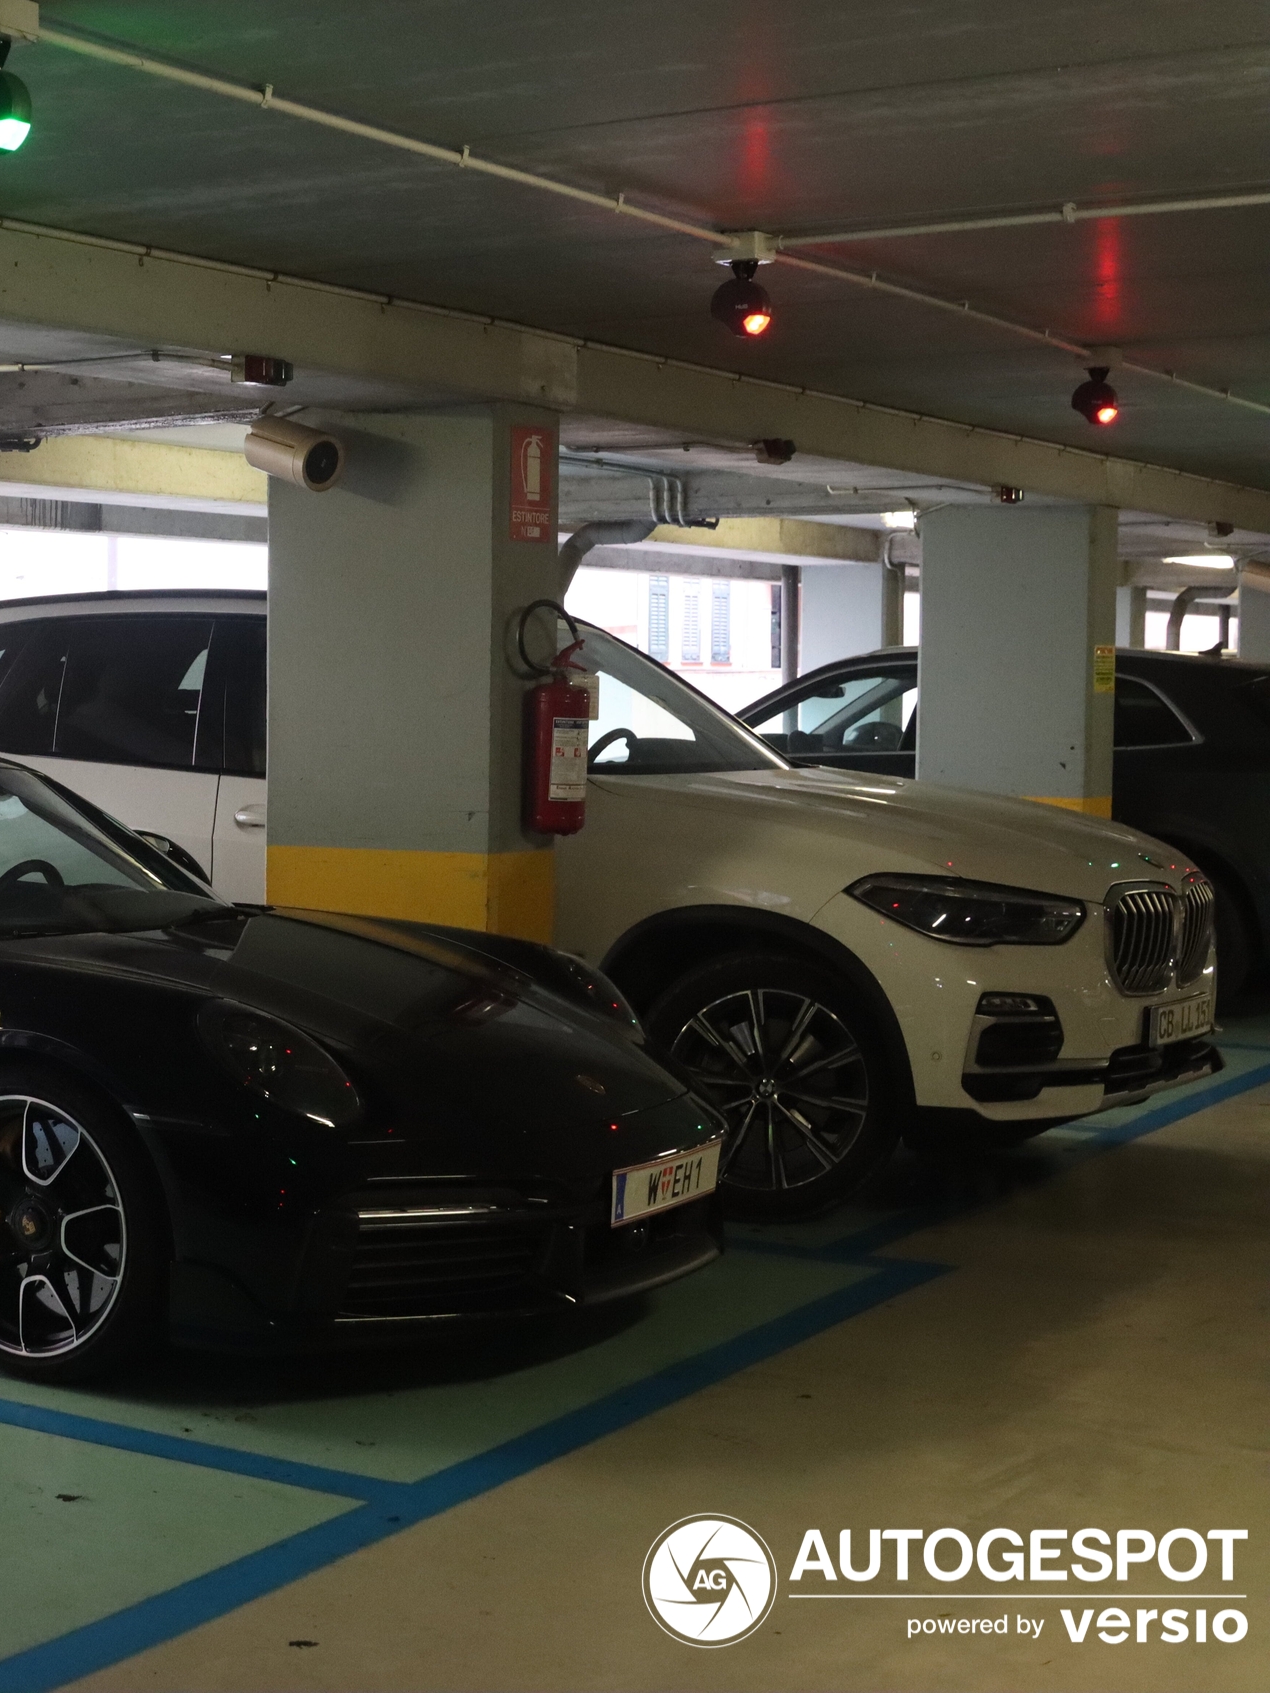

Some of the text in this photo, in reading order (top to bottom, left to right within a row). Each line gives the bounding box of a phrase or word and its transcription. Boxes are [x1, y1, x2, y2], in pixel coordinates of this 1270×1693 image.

[513, 511, 549, 524] ESTINTORE
[1159, 1009, 1175, 1039] CB
[1181, 1004, 1194, 1035] LL
[647, 1170, 663, 1206] W
